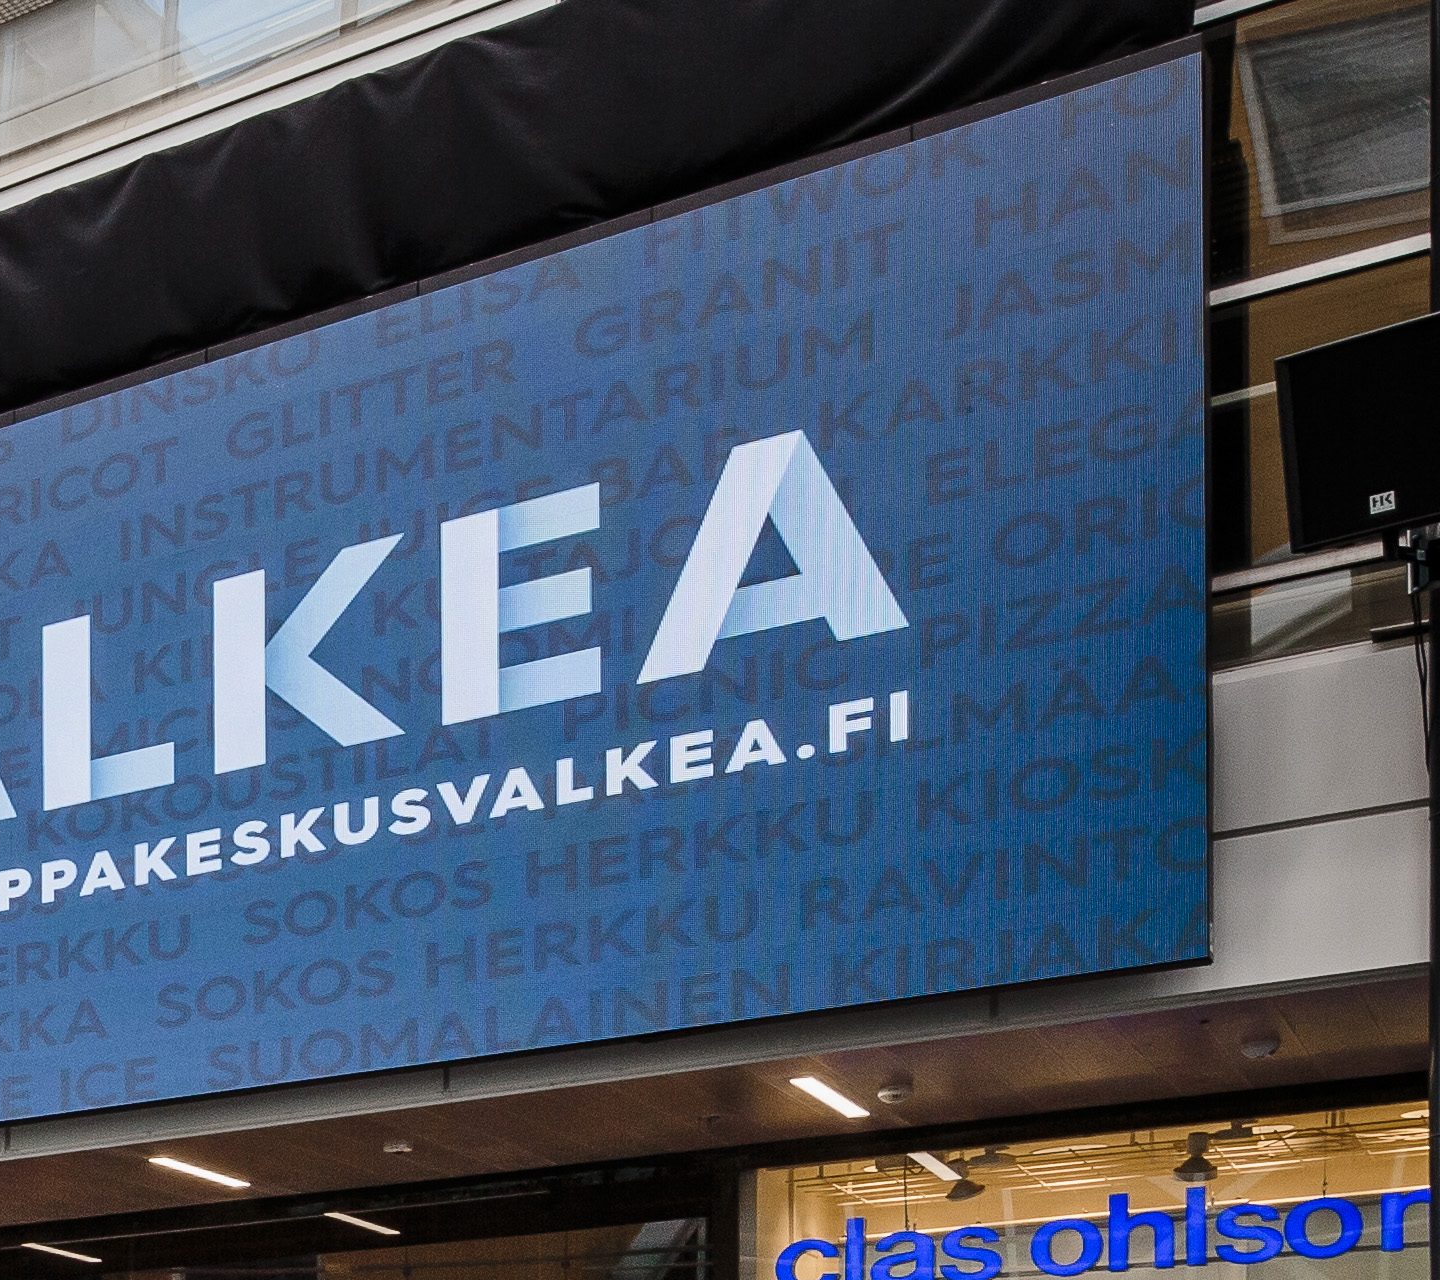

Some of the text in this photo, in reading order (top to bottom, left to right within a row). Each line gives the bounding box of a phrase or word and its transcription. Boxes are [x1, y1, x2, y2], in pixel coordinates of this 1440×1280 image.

[61, 331, 320, 448] DINSKO
[225, 336, 515, 467] GLITTER
[574, 220, 906, 368] GRANIT
[120, 312, 873, 566] INSTRUMENTARIUM
[27, 711, 494, 854] KOKOUSTILAT
[563, 635, 850, 746] PICNIC
[243, 859, 492, 948] SOKOS
[525, 791, 874, 901] HERKKU
[155, 949, 395, 1031] SOKOS
[426, 890, 758, 990] HERKKU
[61, 1055, 158, 1112] ICE
[206, 963, 790, 1092] SUOMALAINEN
[1030, 1185, 1432, 1279] ohlson
